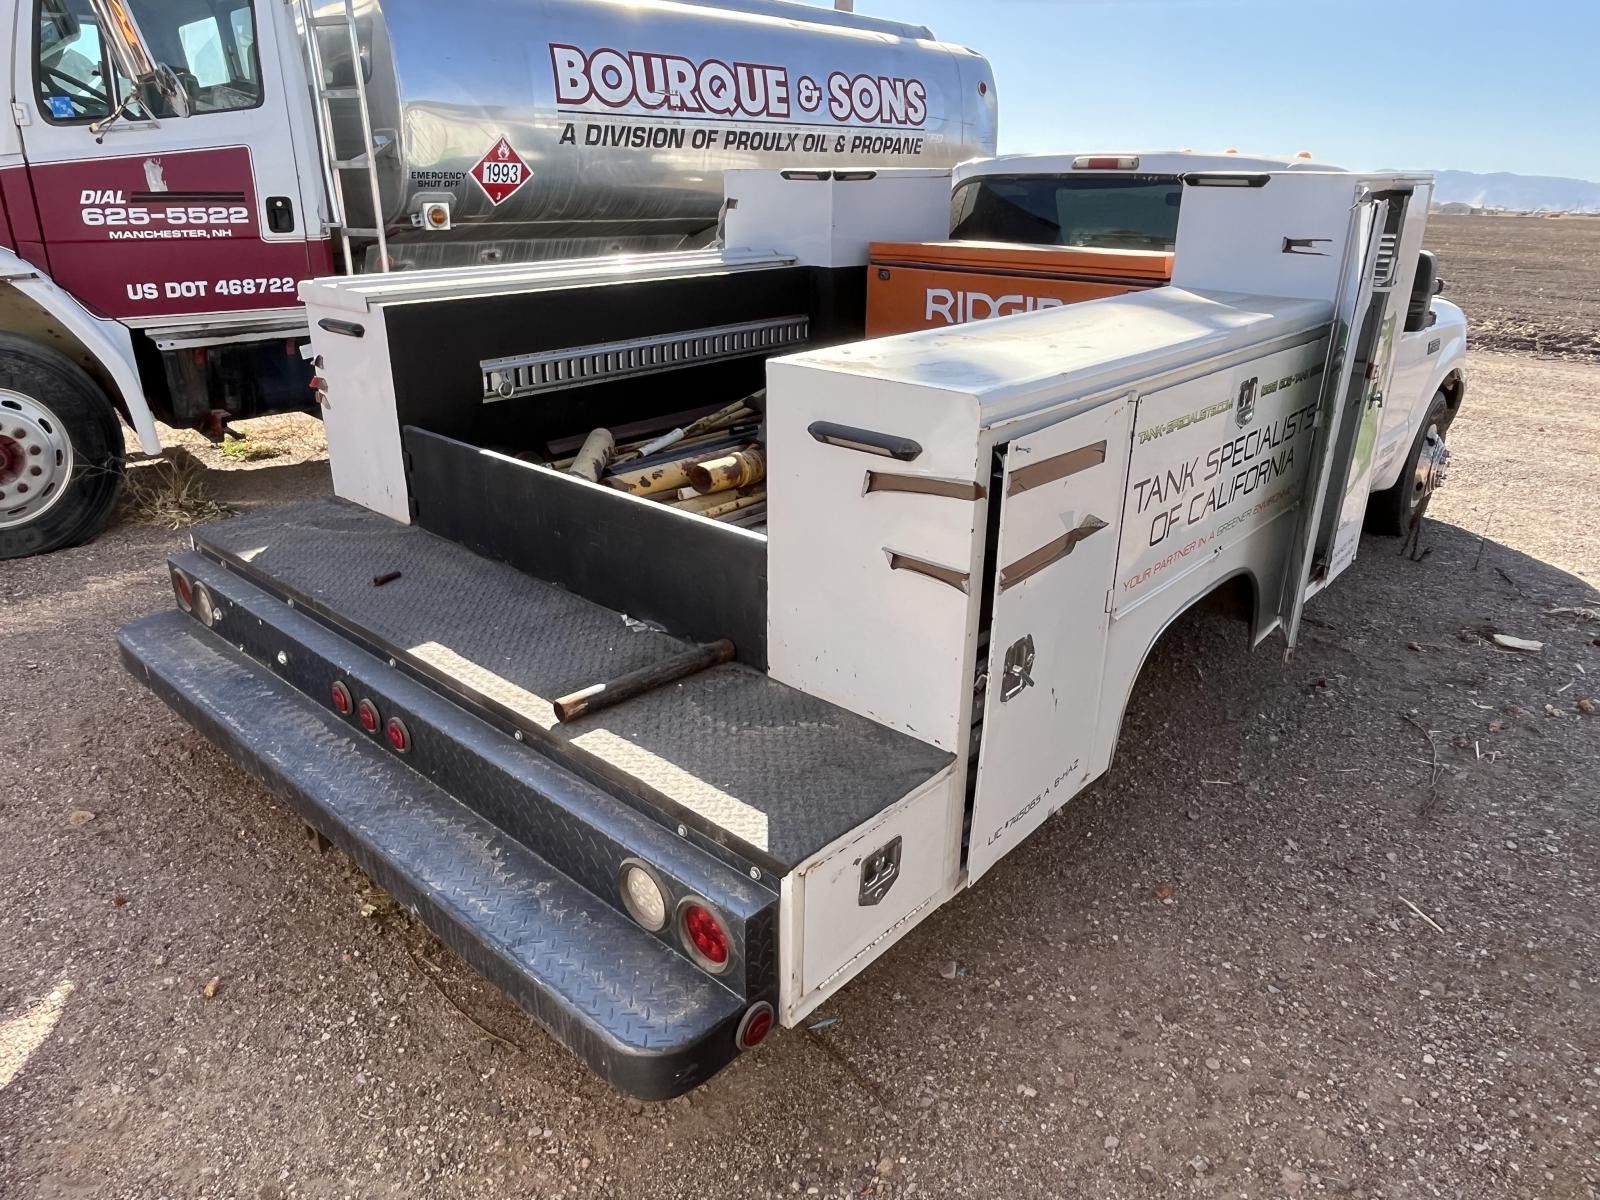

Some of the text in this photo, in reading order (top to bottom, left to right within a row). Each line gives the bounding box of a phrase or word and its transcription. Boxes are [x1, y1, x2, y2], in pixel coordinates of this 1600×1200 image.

[549, 43, 926, 126] BOURQUE & SONS
[559, 123, 924, 155] A DIVISION OF PROULX OIL & PROPANE
[411, 171, 467, 180] EMERGENCY
[485, 163, 519, 184] 1993
[418, 180, 461, 188] SHUT OFF
[79, 190, 127, 205] DIAL
[495, 192, 502, 201] 3
[81, 207, 249, 226] 625-5522
[109, 229, 232, 239] MANCHESTER, NH
[126, 277, 296, 300] US DOT 468722
[1134, 403, 1316, 514] TANK SPECIALISTS
[1150, 447, 1294, 547] OF CALIFORNIA
[1123, 567, 1152, 592] YOUR
[1153, 541, 1197, 575] PARTNER
[1198, 536, 1207, 549] IN
[1043, 787, 1050, 797] A
